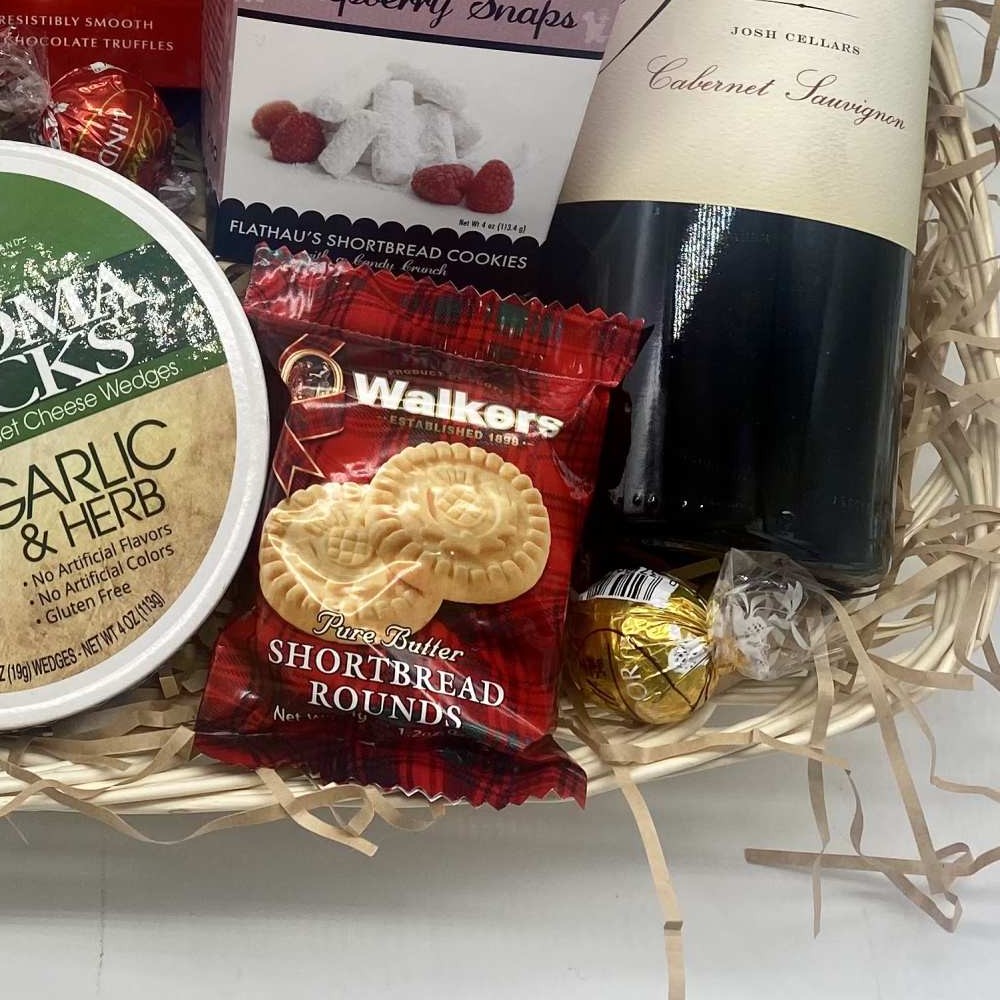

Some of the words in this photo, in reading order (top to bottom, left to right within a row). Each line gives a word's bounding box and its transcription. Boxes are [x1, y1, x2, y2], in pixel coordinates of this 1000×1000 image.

[85, 16, 154, 30] SMOOTH
[102, 38, 175, 51] TRUFFLES
[730, 25, 777, 40] JOSH
[785, 31, 861, 56] CELLARS
[646, 54, 776, 97] Cabernet
[785, 68, 906, 131] Sauvignon
[229, 219, 322, 246] FLATHAU'S
[326, 234, 442, 261] SHORTBREAD
[446, 248, 528, 270] COOKIES
[352, 254, 395, 271] Candy
[402, 261, 448, 277] Crunch
[23, 390, 98, 430] Cheese
[352, 371, 564, 438] Walkers
[389, 415, 483, 440] ESTABLISHED
[20, 523, 58, 563] &
[59, 478, 166, 548] HERB
[31, 569, 55, 588] No
[58, 542, 117, 578] Artificial
[119, 522, 173, 557] Flavors
[38, 588, 61, 607] No
[65, 561, 124, 597] Artificial
[126, 543, 175, 571] Colors
[45, 596, 96, 625] Gluten
[99, 580, 132, 600] Free
[7, 662, 32, 685] (19g)
[31, 647, 78, 676] WEDGES
[81, 634, 101, 657] NET
[100, 626, 119, 648] WT
[118, 622, 127, 636] 4
[123, 610, 141, 631] OZ
[136, 588, 166, 621] (113g)
[313, 610, 378, 645] Pure
[382, 624, 464, 662] Butter
[268, 639, 505, 707] SHORTBREAD
[308, 680, 463, 729] ROUNDS
